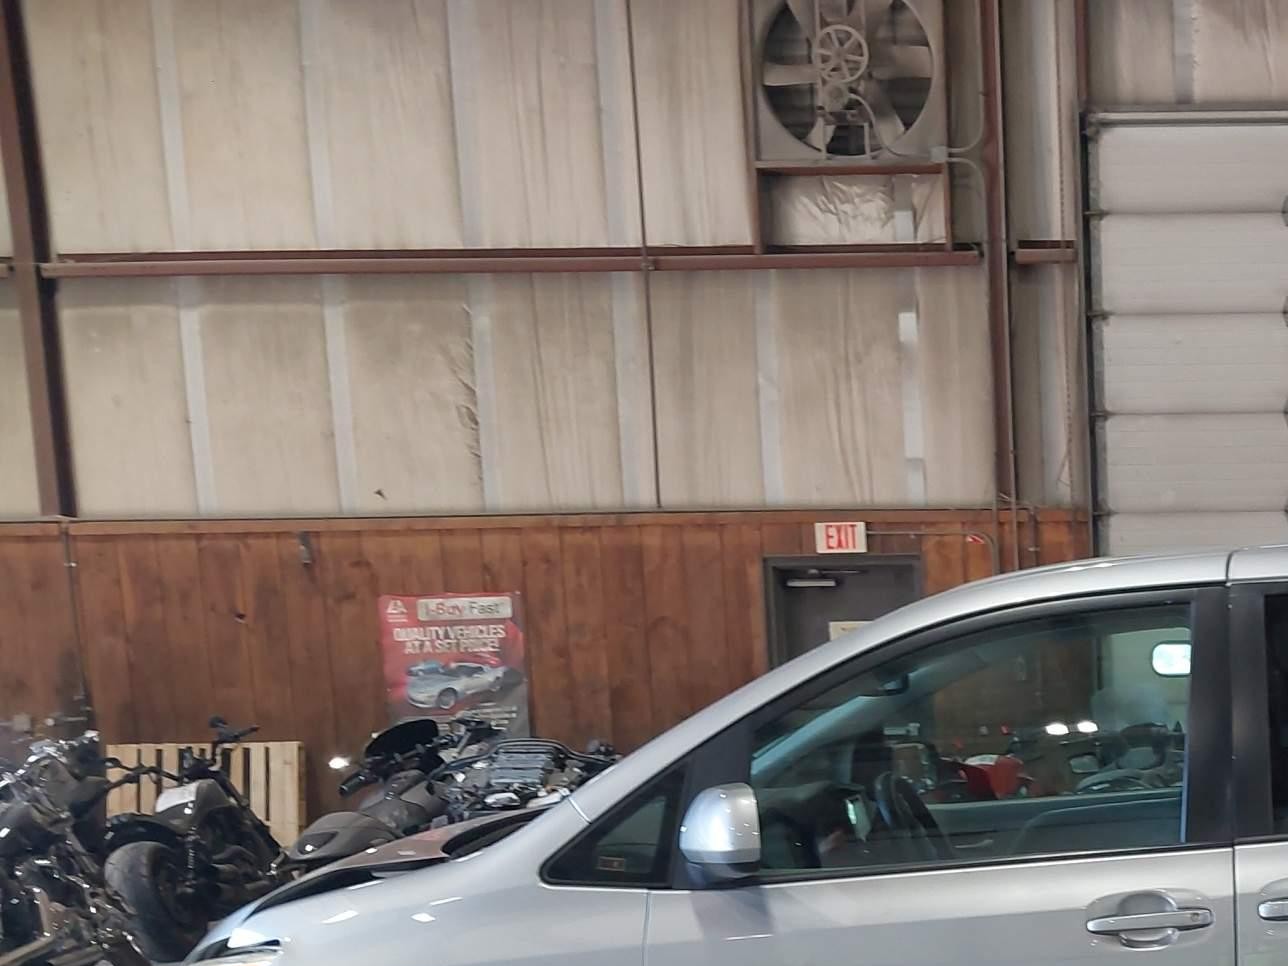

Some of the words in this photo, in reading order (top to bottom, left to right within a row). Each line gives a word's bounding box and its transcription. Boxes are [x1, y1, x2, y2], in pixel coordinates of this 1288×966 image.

[825, 524, 858, 550] EXIT
[468, 601, 500, 615] Fast
[392, 627, 446, 641] QUALITY
[446, 625, 506, 639] VEHICLES
[404, 640, 421, 654] AT
